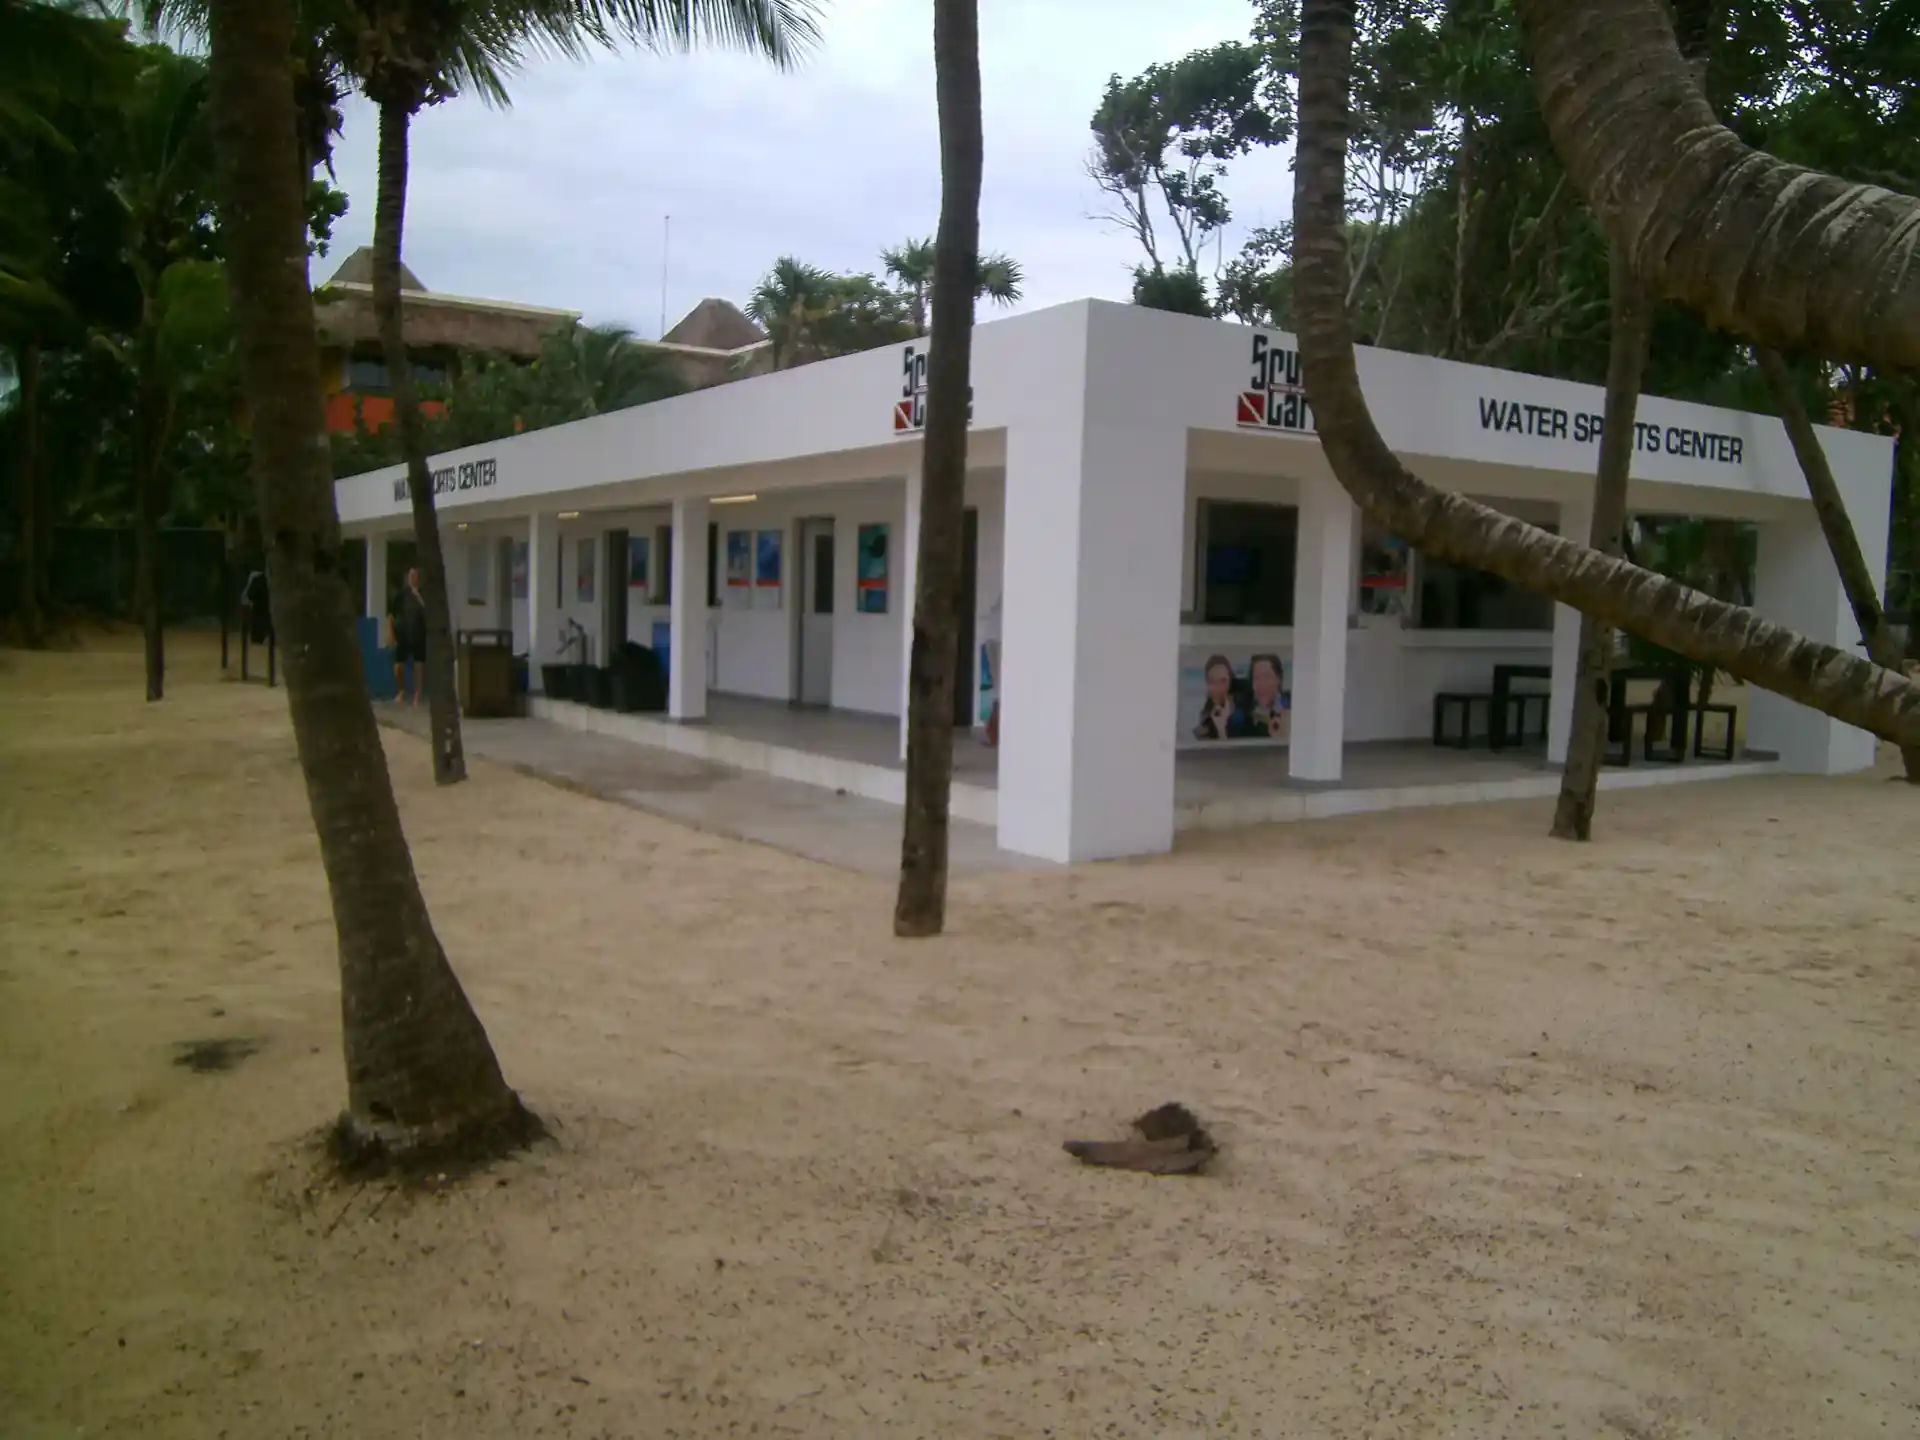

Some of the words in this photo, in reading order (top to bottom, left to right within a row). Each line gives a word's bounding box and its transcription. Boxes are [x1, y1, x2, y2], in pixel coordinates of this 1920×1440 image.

[1251, 334, 1300, 390] Scu
[1267, 388, 1317, 430] Car
[1479, 396, 1567, 439] WATER
[1574, 413, 1660, 452] SPTS
[1666, 427, 1743, 464] CENTER
[432, 466, 456, 494] ORTS
[459, 457, 497, 490] CENTER
